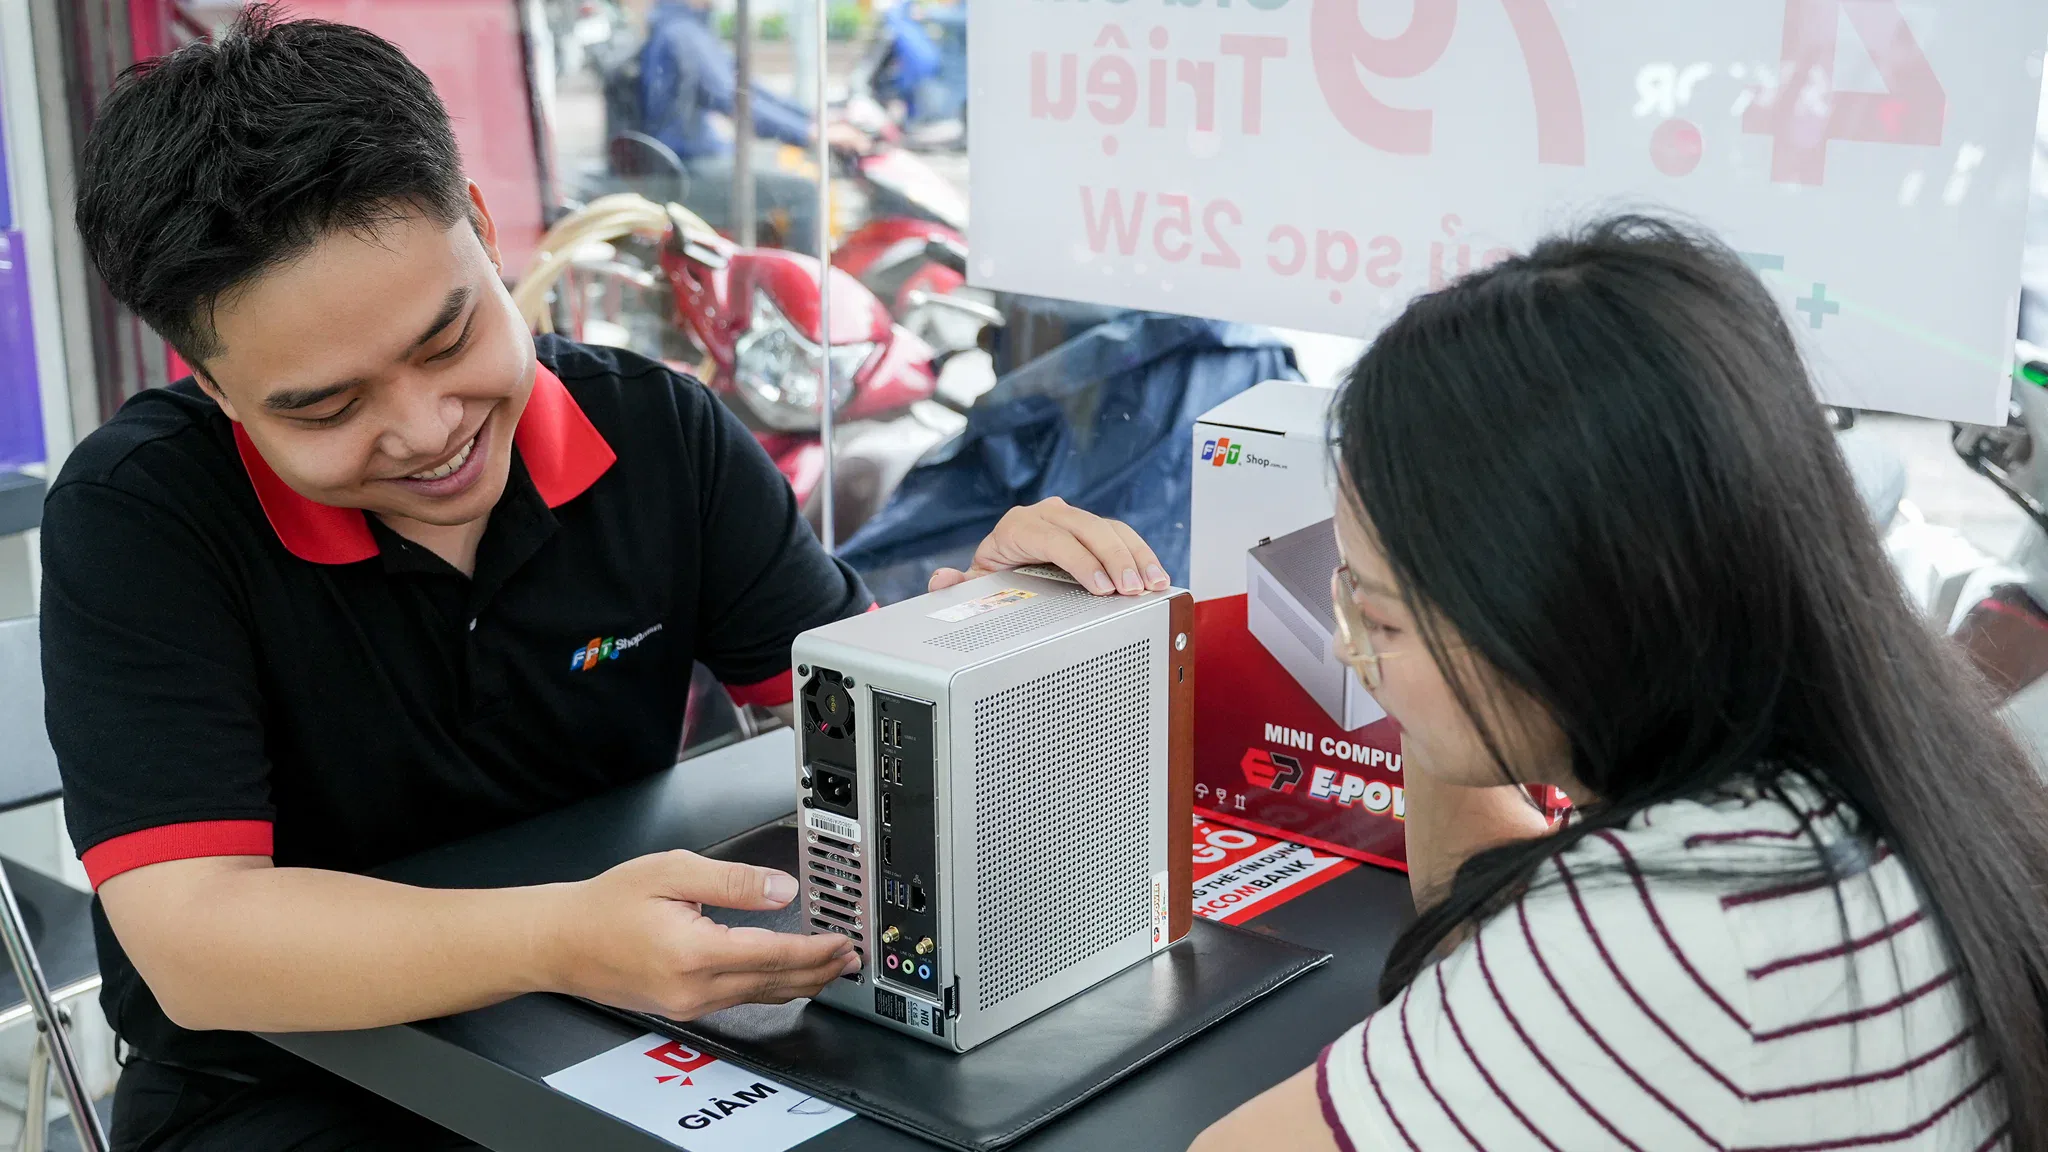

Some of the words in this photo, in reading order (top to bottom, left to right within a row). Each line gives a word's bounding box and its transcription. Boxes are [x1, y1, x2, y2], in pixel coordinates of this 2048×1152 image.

[1202, 440, 1240, 464] FPT
[571, 640, 613, 669] FPT
[1265, 722, 1314, 751] MINI
[1320, 737, 1402, 772] COMPU
[1202, 873, 1240, 889] THẺ
[678, 1082, 779, 1130] GIẢM
